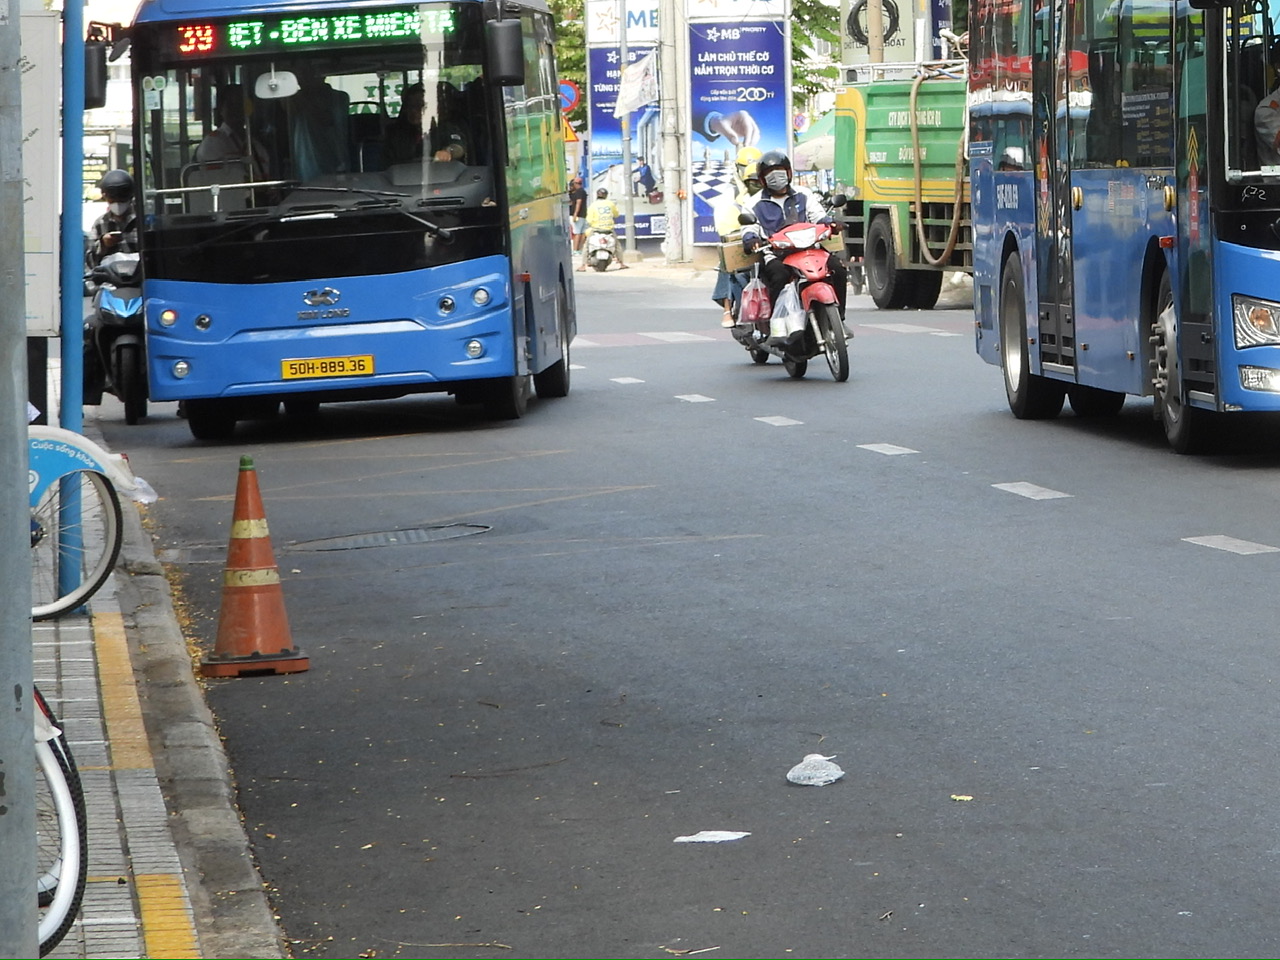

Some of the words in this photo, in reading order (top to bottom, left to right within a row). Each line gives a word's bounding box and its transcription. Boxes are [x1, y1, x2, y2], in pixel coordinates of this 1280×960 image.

[178, 25, 213, 52] 39
[720, 28, 741, 40] MB
[698, 51, 717, 62] LÀM
[718, 50, 736, 62] CHỦ
[738, 50, 755, 62] THẾ
[714, 65, 738, 77] TRỌN
[736, 87, 767, 102] 200
[289, 359, 366, 376] 50H-889.36
[31, 441, 54, 451] Cuộc
